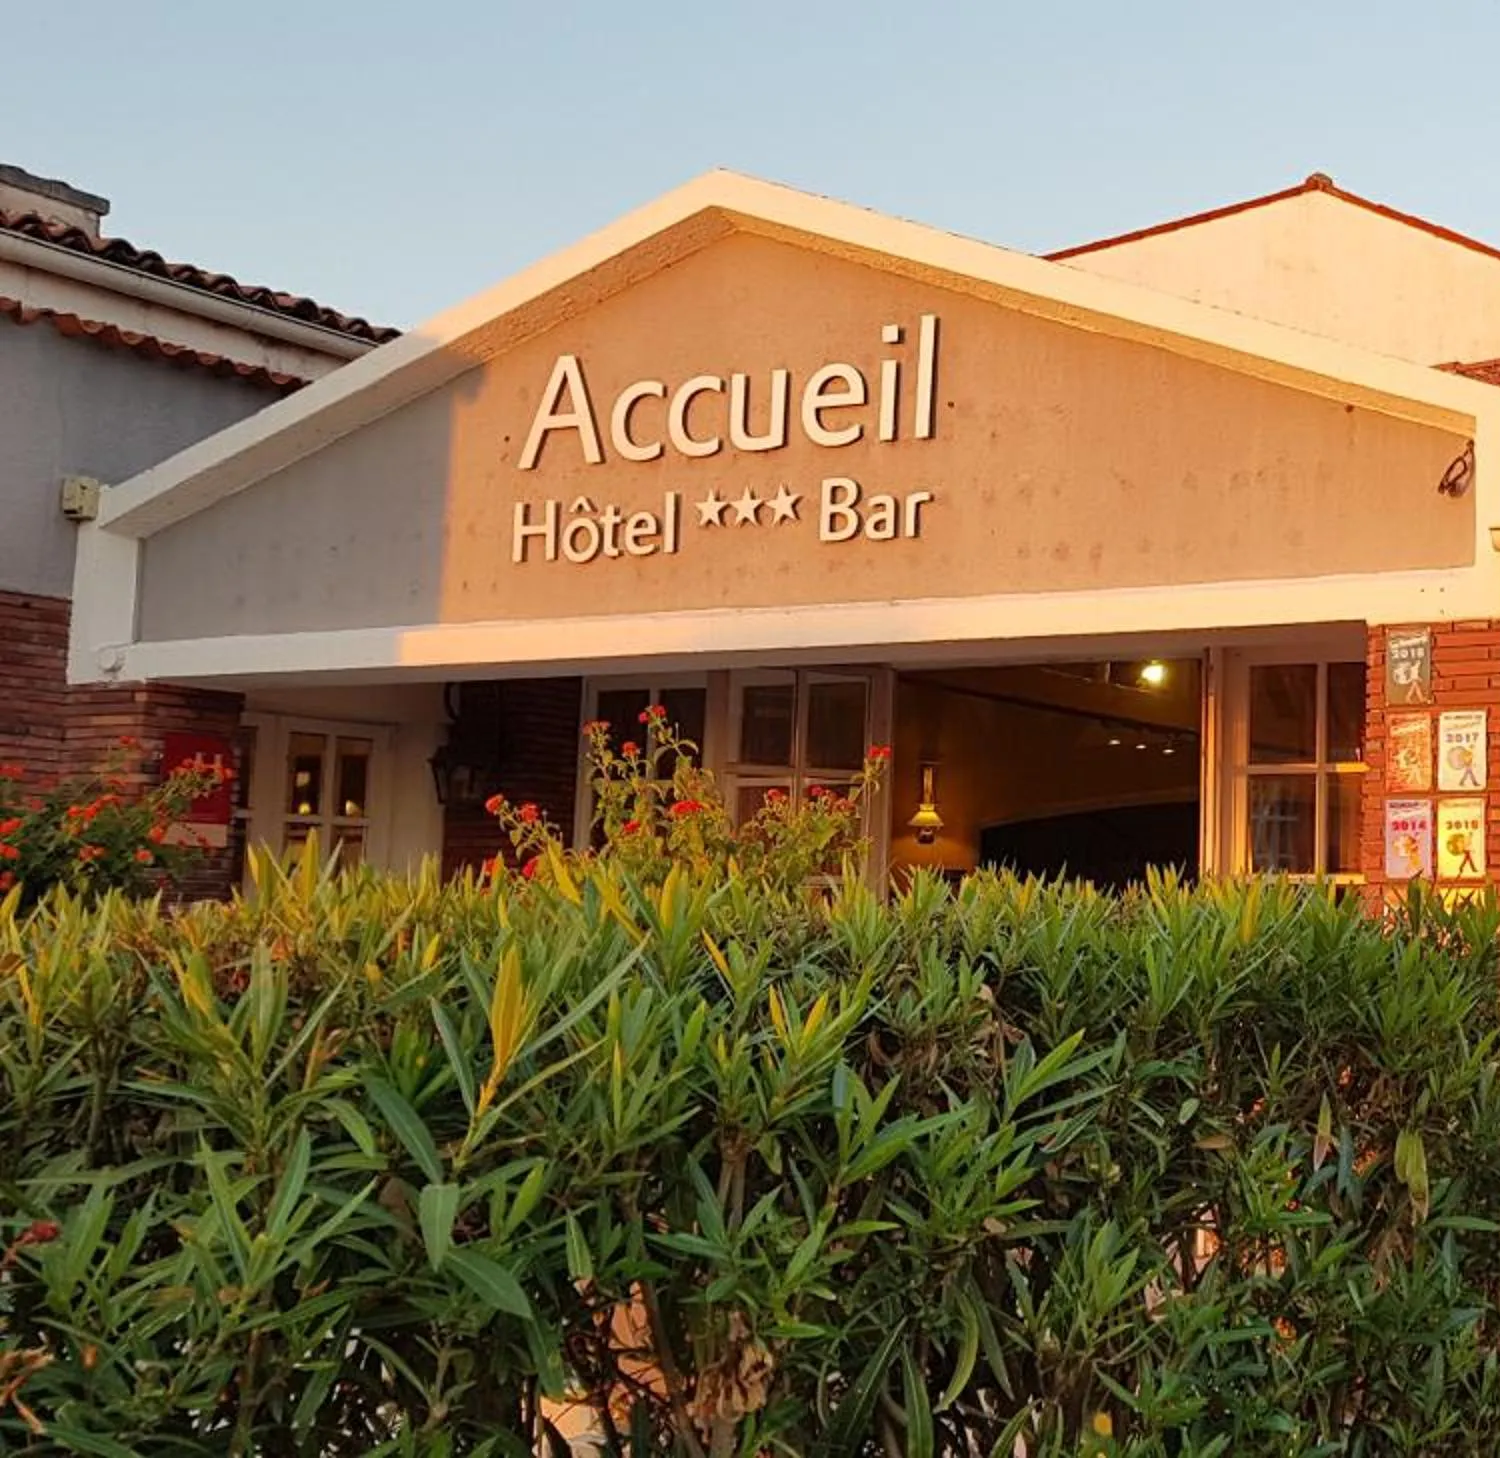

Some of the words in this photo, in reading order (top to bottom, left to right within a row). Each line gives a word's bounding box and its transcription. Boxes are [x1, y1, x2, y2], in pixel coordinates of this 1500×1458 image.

[518, 314, 938, 470] Accueil
[511, 490, 680, 564] Hôtel
[818, 477, 934, 542] Bar
[1445, 732, 1479, 743] 2017
